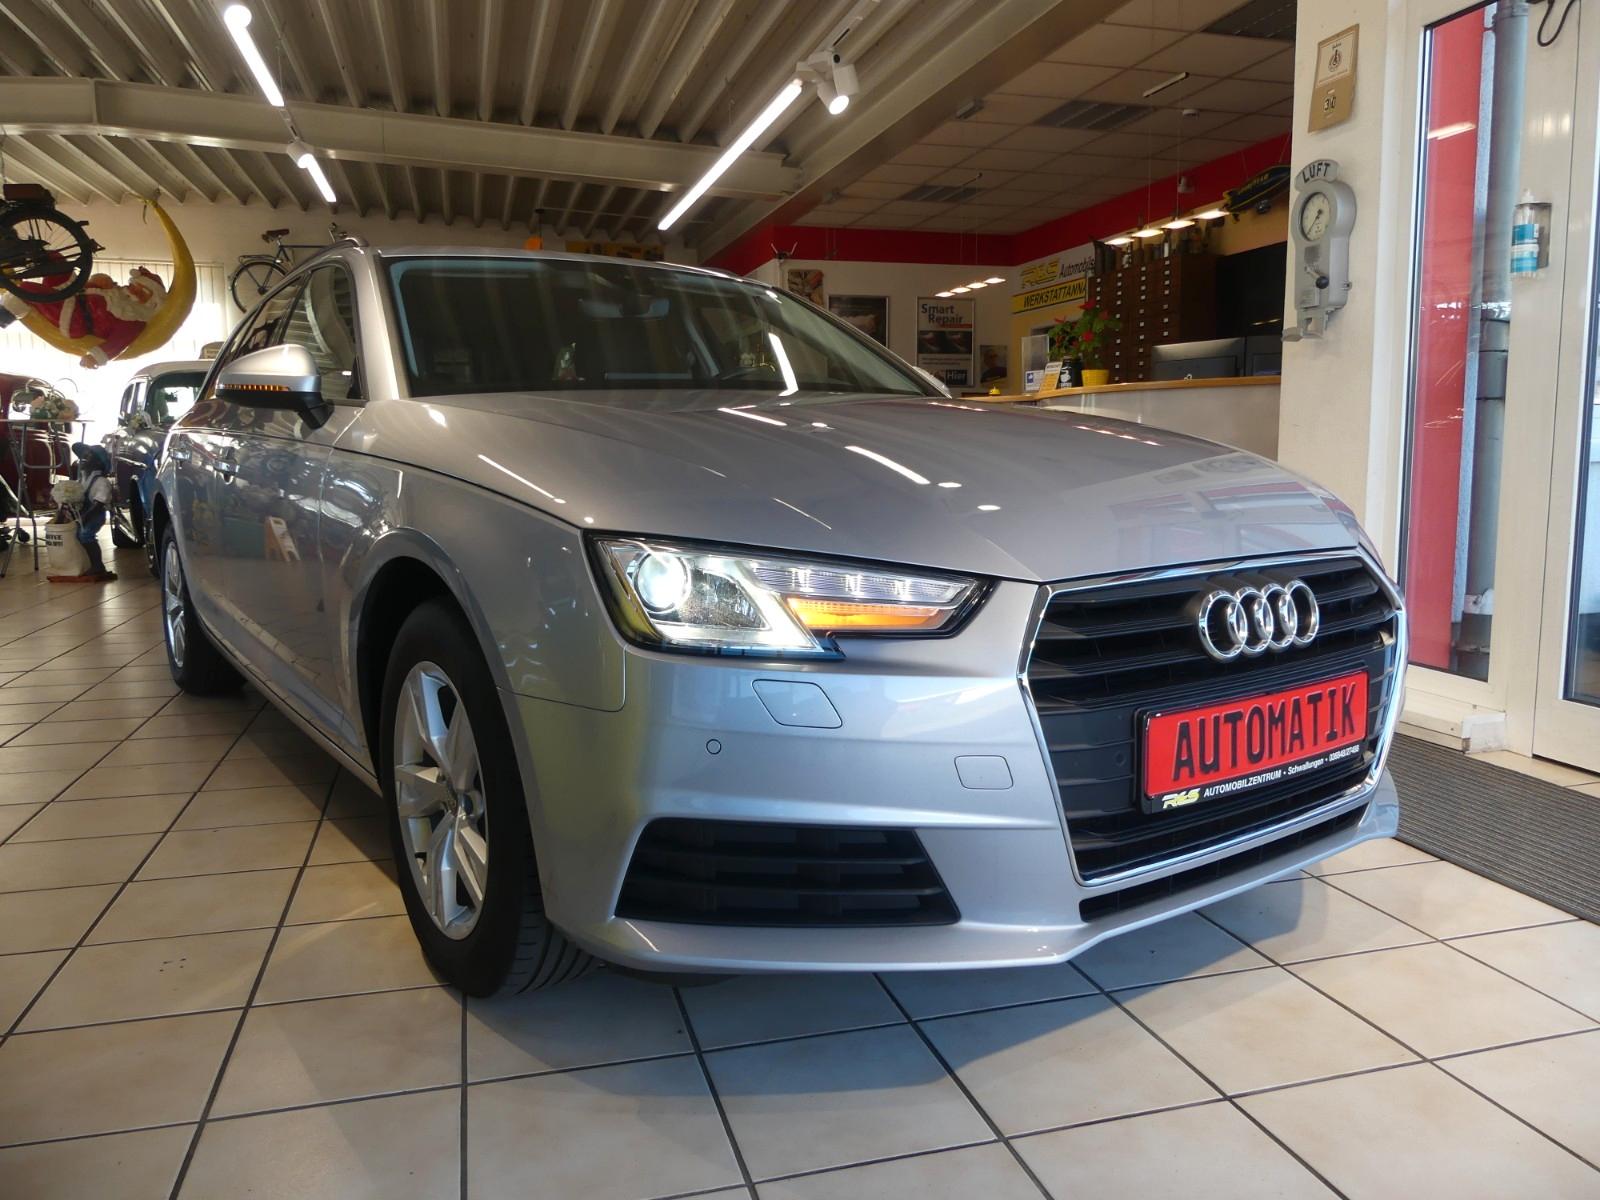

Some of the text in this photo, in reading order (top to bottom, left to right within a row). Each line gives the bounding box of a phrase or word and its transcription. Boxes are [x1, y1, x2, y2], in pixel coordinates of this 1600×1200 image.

[1302, 162, 1331, 183] LUFT
[921, 303, 955, 314] Smart
[928, 313, 964, 325] Repair
[1172, 682, 1356, 781] AUTOMATIK
[1203, 769, 1282, 798] AUTOMOBILZENTRUM
[1287, 758, 1324, 775] Schwallungen
